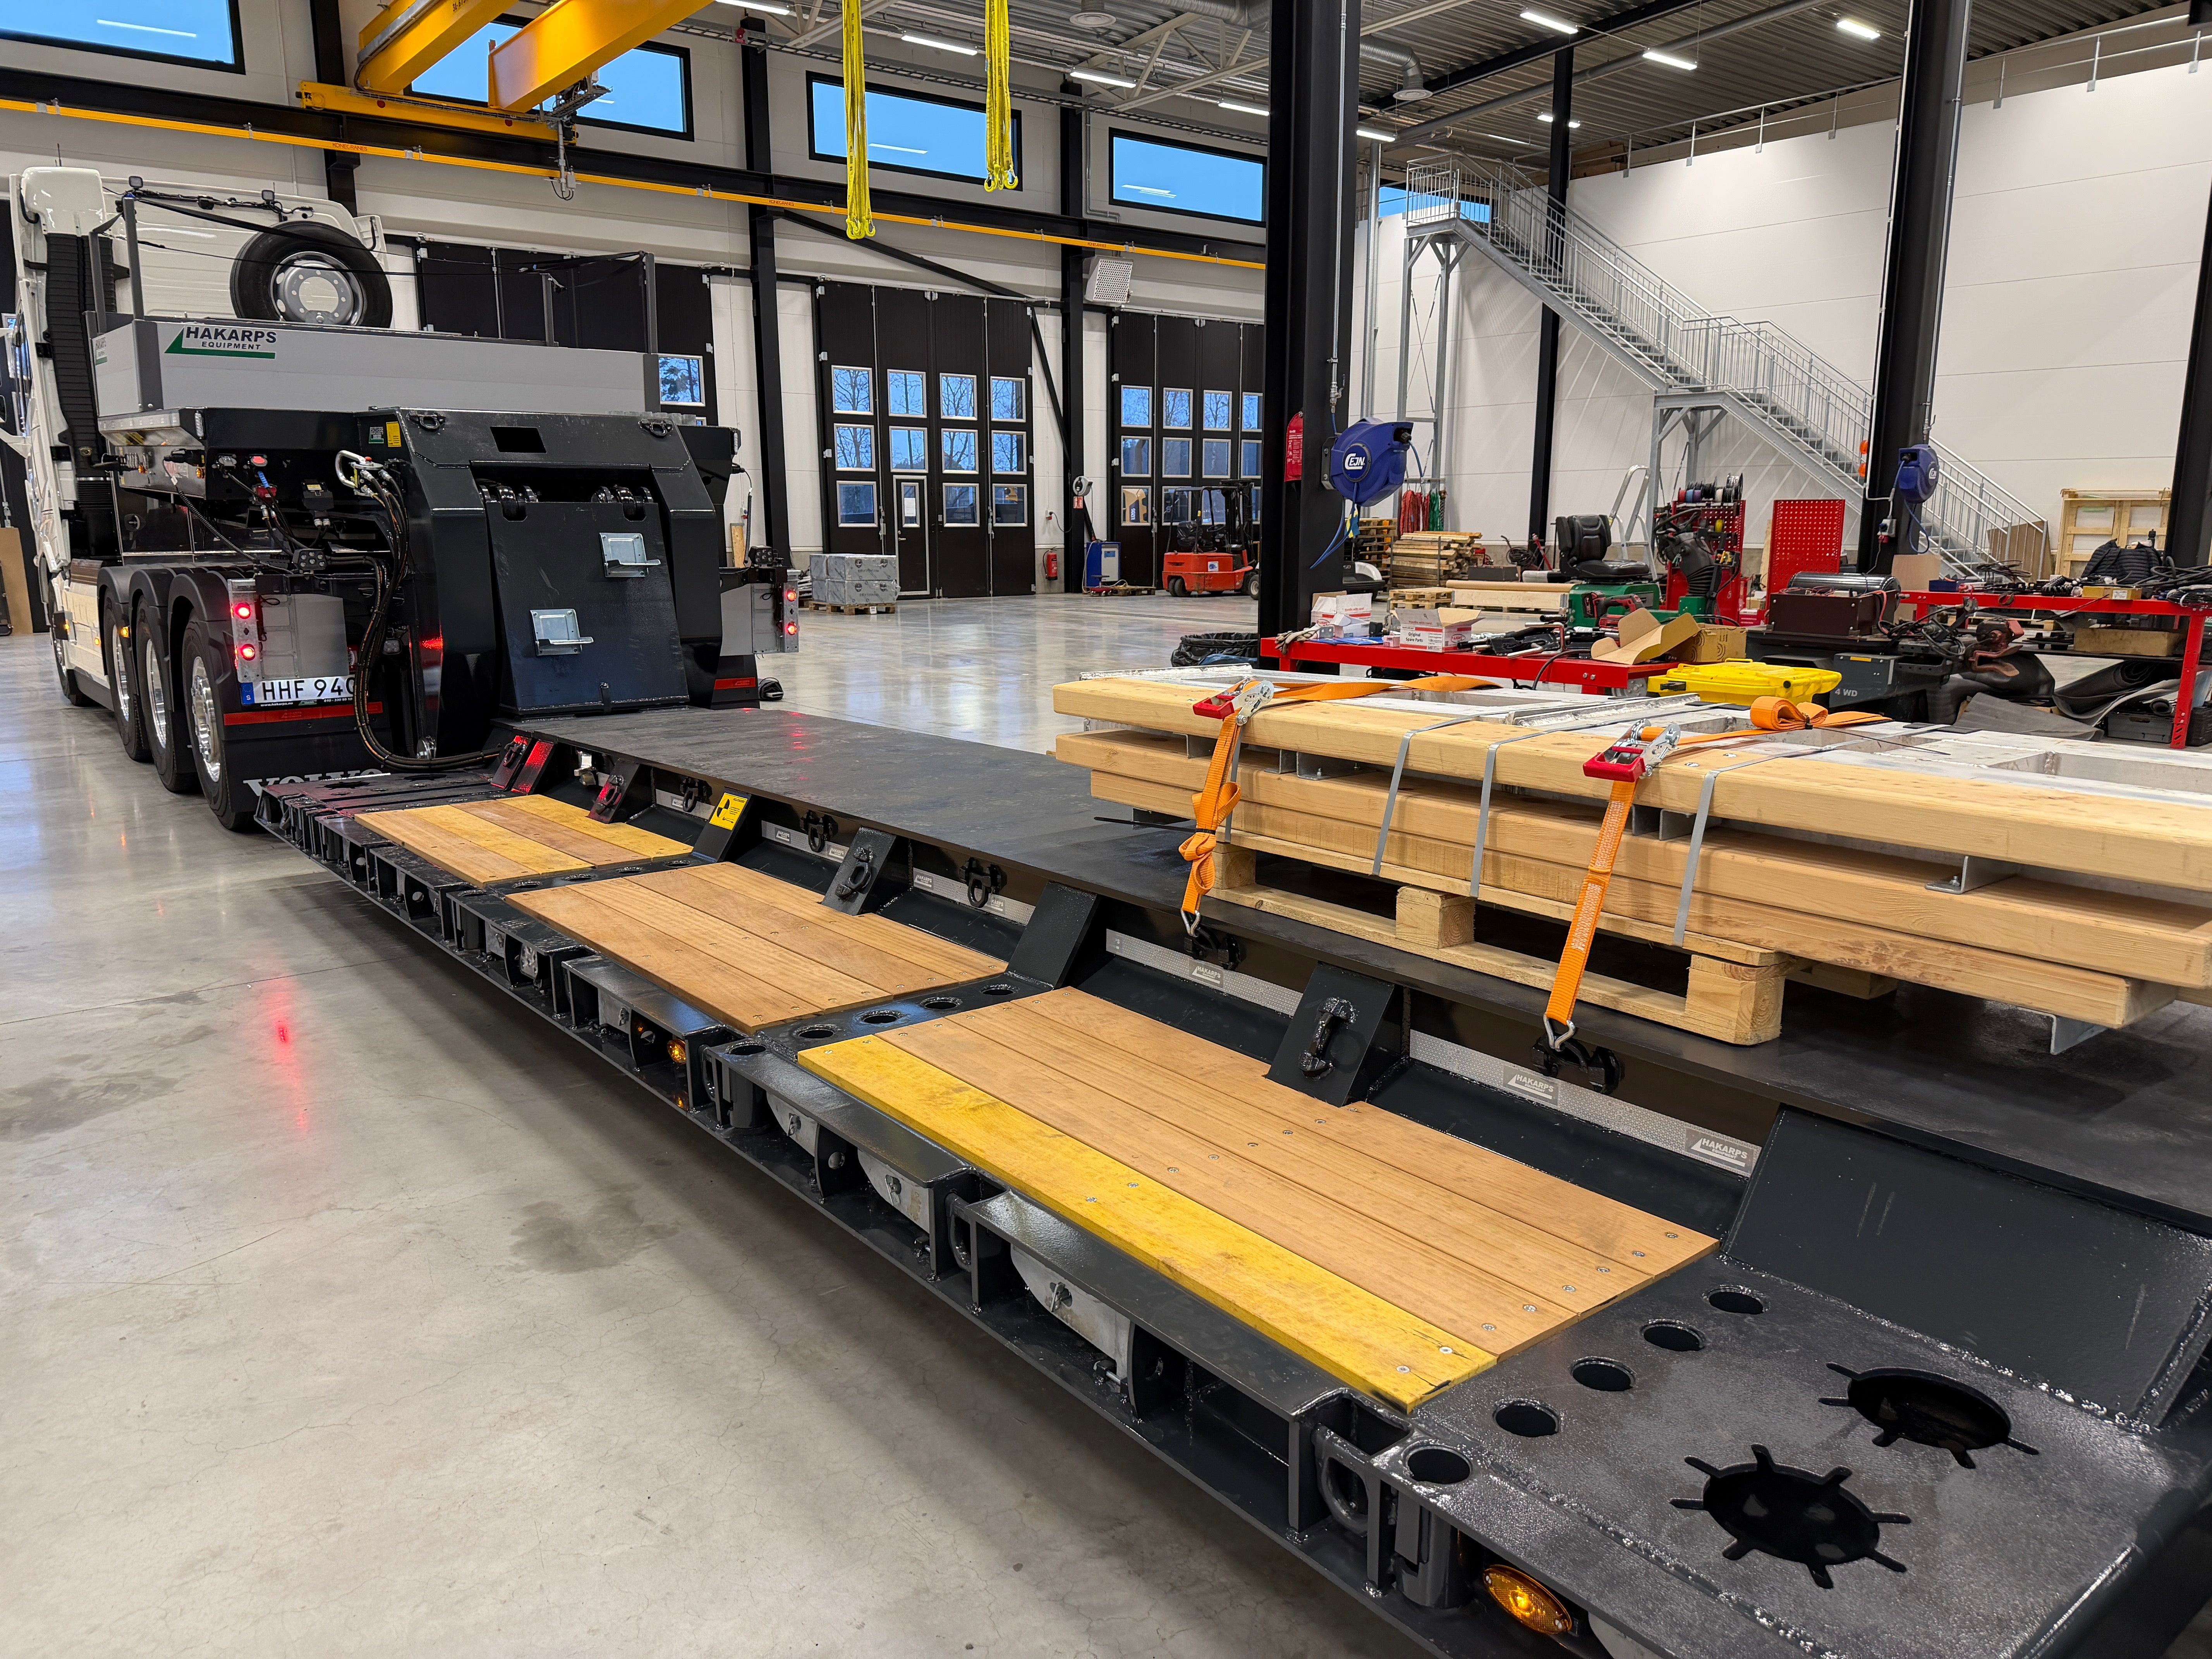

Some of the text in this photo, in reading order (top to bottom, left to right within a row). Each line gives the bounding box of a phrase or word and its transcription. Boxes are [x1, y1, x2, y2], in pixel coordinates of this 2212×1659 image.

[186, 326, 276, 343] HAKARPS
[201, 341, 261, 350] EQUIPMENT
[1345, 453, 1365, 470] CEJN
[262, 680, 305, 700] HHF
[1197, 966, 1221, 978] HAKARPS
[1516, 1074, 1554, 1092] HAKARPS
[1702, 1138, 1748, 1159] HAKARPS
